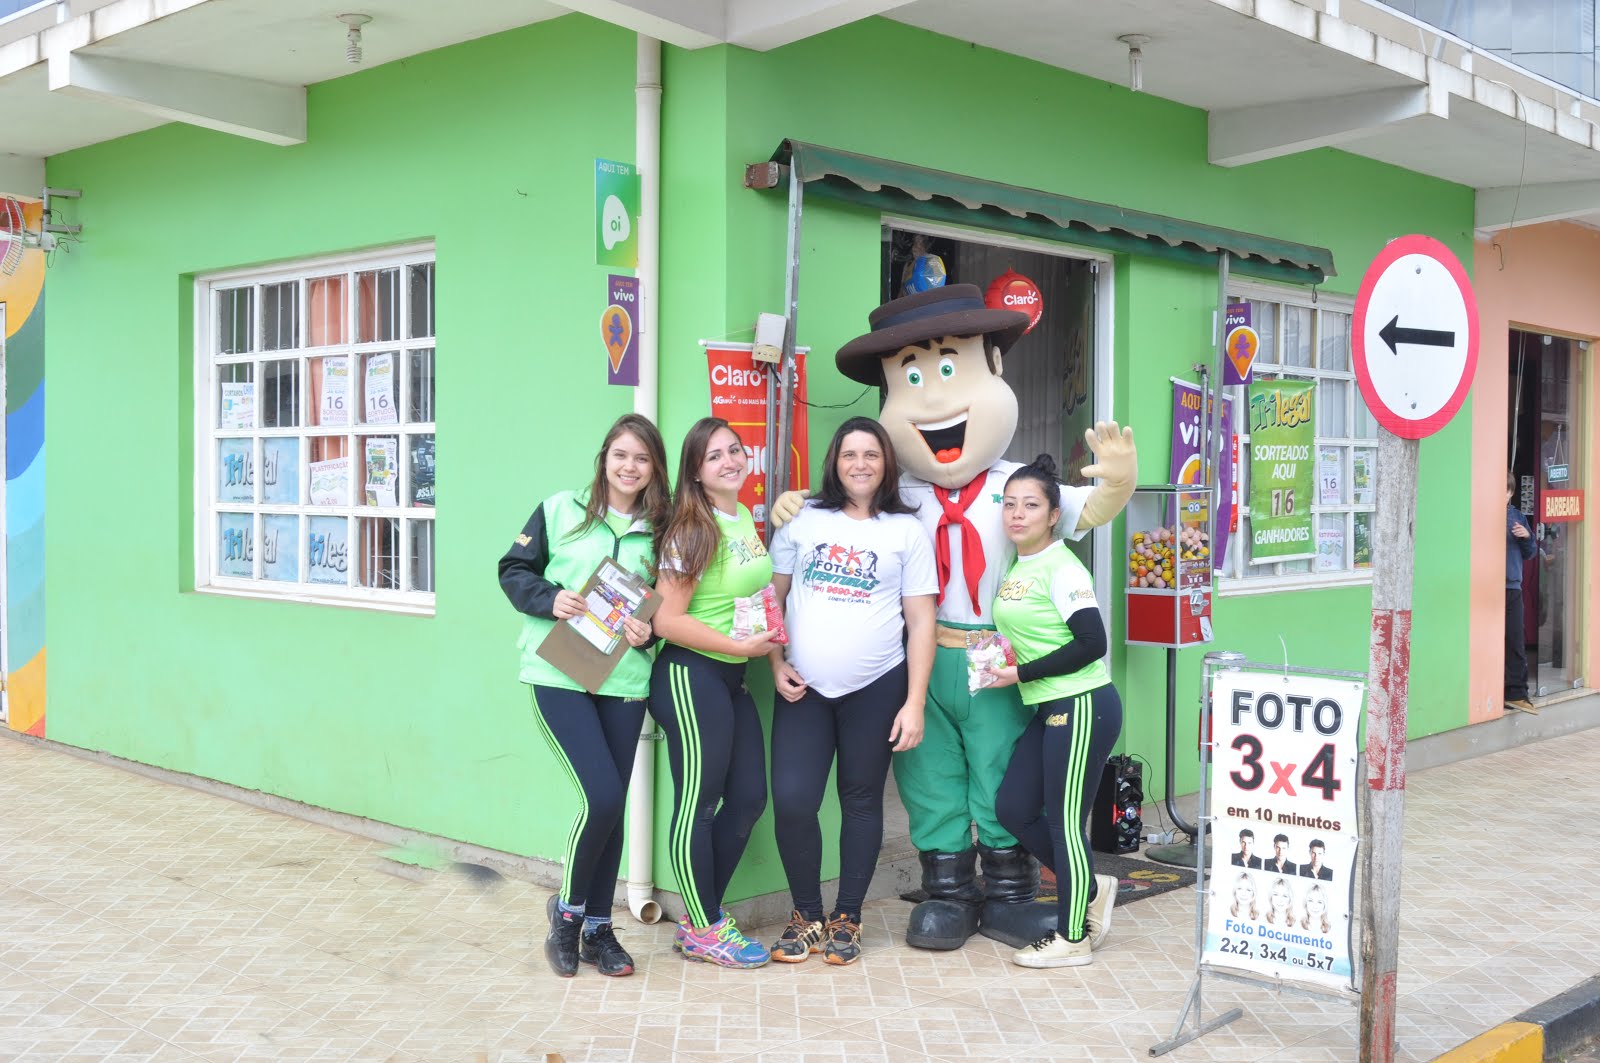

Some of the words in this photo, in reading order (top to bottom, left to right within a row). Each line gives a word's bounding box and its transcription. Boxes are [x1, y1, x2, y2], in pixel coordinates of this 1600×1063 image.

[599, 161, 615, 172] AQUI
[617, 165, 630, 175] TEM
[610, 215, 621, 231] oi
[614, 289, 635, 302] vivo
[1003, 293, 1036, 305] Claro
[711, 364, 762, 387] Claro
[327, 396, 344, 410] 16
[370, 394, 389, 411] 16
[1181, 391, 1201, 410] AQU
[1251, 389, 1313, 432] Trilegal
[1254, 445, 1310, 461] SORTEADOS
[1271, 463, 1297, 479] AQUI
[1323, 477, 1337, 489] 16
[1273, 489, 1295, 516] 16
[1546, 496, 1580, 517] BARBEARIA
[1255, 527, 1310, 545] GANHADORES
[803, 560, 880, 591] AVENTURAS
[816, 559, 863, 578] FOTOS
[1231, 689, 1343, 736] FOTO
[1230, 734, 1341, 801] 3x4
[1227, 806, 1249, 818] em
[1255, 808, 1273, 821] 10
[1278, 812, 1341, 831] minutos
[1226, 919, 1253, 935] Foto
[1258, 925, 1332, 950] Documento
[1220, 937, 1254, 959] 2x2,
[1260, 943, 1287, 962] 3x4
[1292, 957, 1304, 966] ou
[1307, 952, 1334, 971] 5x7
